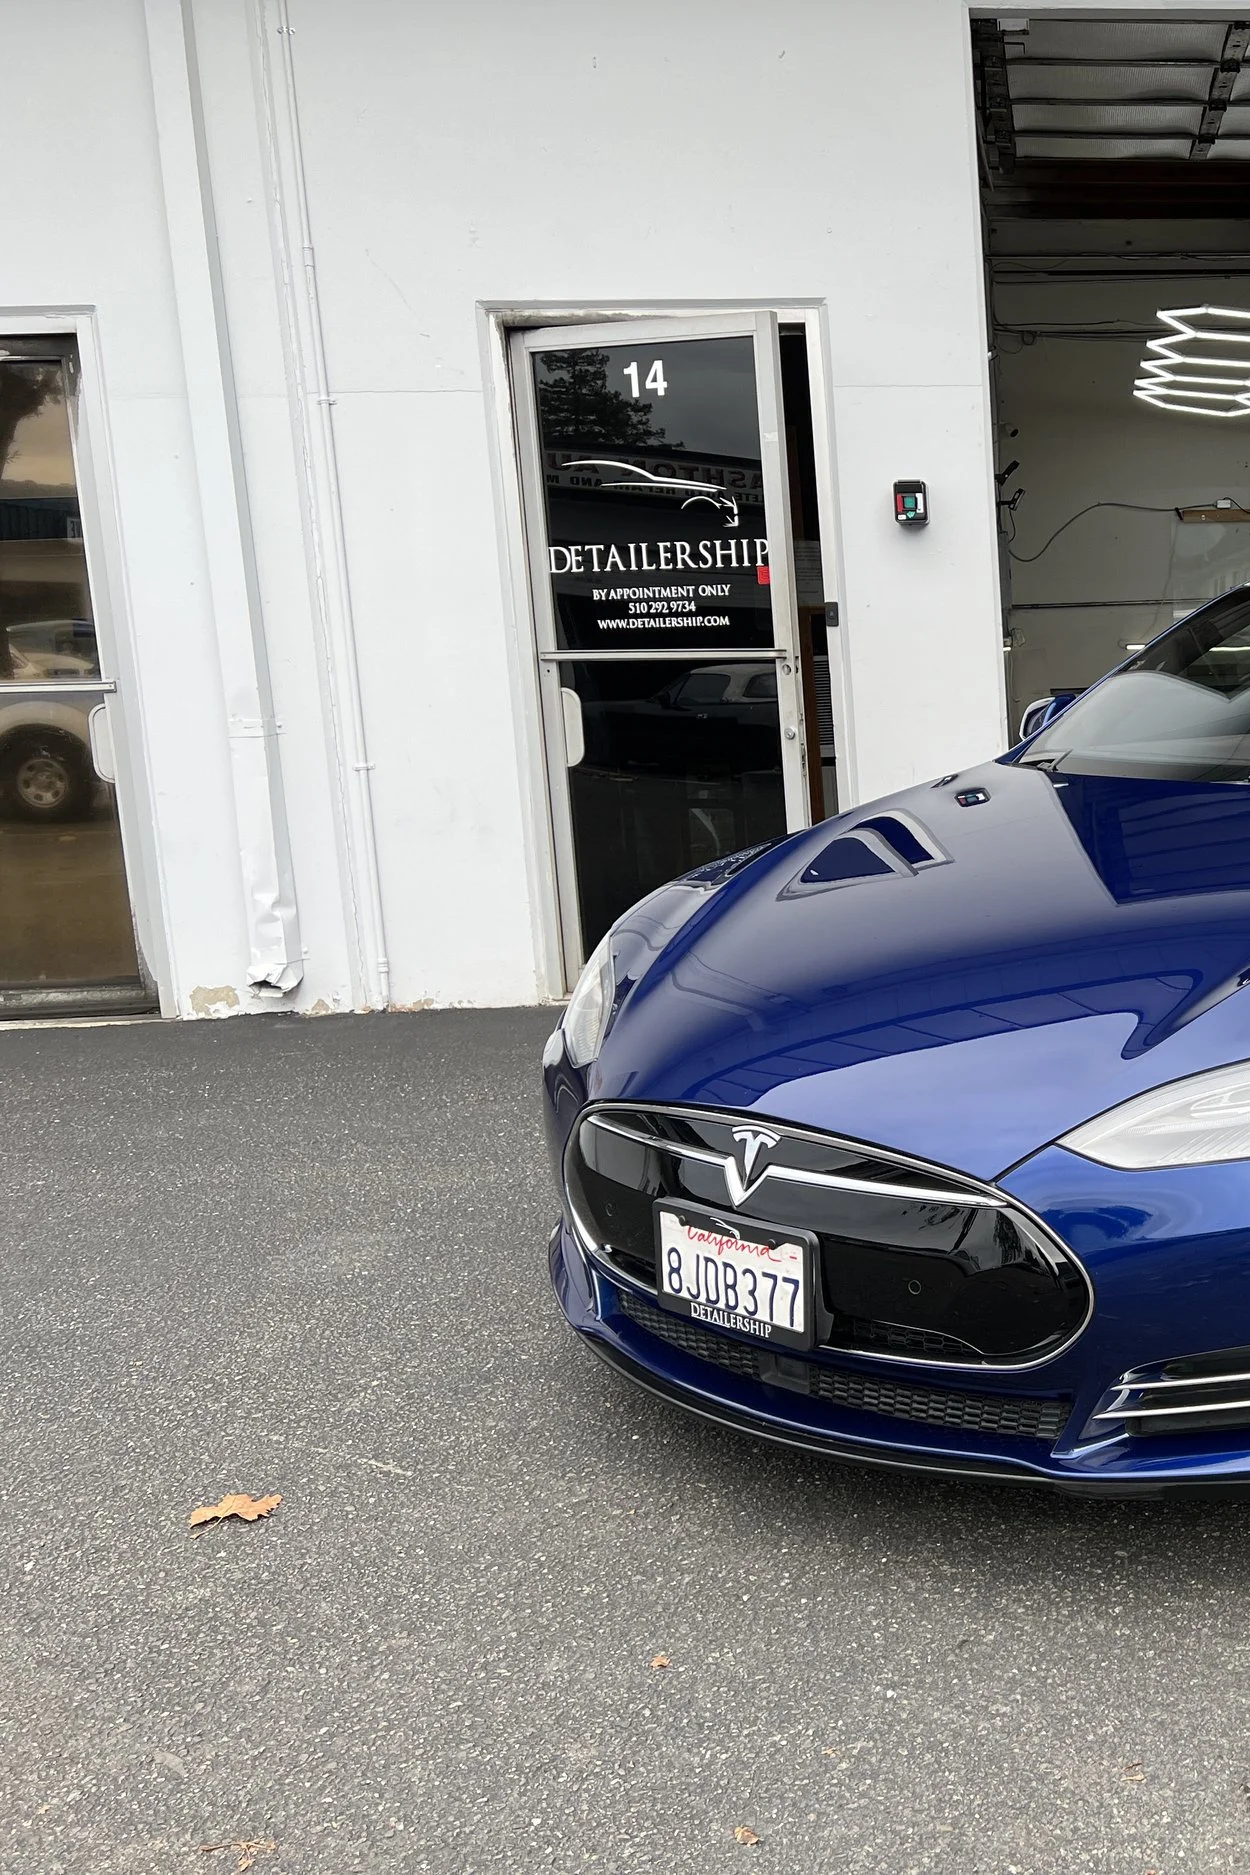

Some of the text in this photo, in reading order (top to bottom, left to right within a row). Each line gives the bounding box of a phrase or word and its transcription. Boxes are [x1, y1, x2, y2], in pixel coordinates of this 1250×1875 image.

[623, 360, 668, 398] 14
[548, 538, 769, 574] DETAILERSHIP
[592, 584, 731, 601] BY APPOINTMENT ONLY
[628, 601, 697, 614] 510 292 9734
[597, 616, 730, 630] WWW.DETAILERSHIP.COM
[687, 1226, 782, 1262] California
[667, 1247, 800, 1327] 8JDB377
[690, 1302, 772, 1338] DETAILERSHIP
